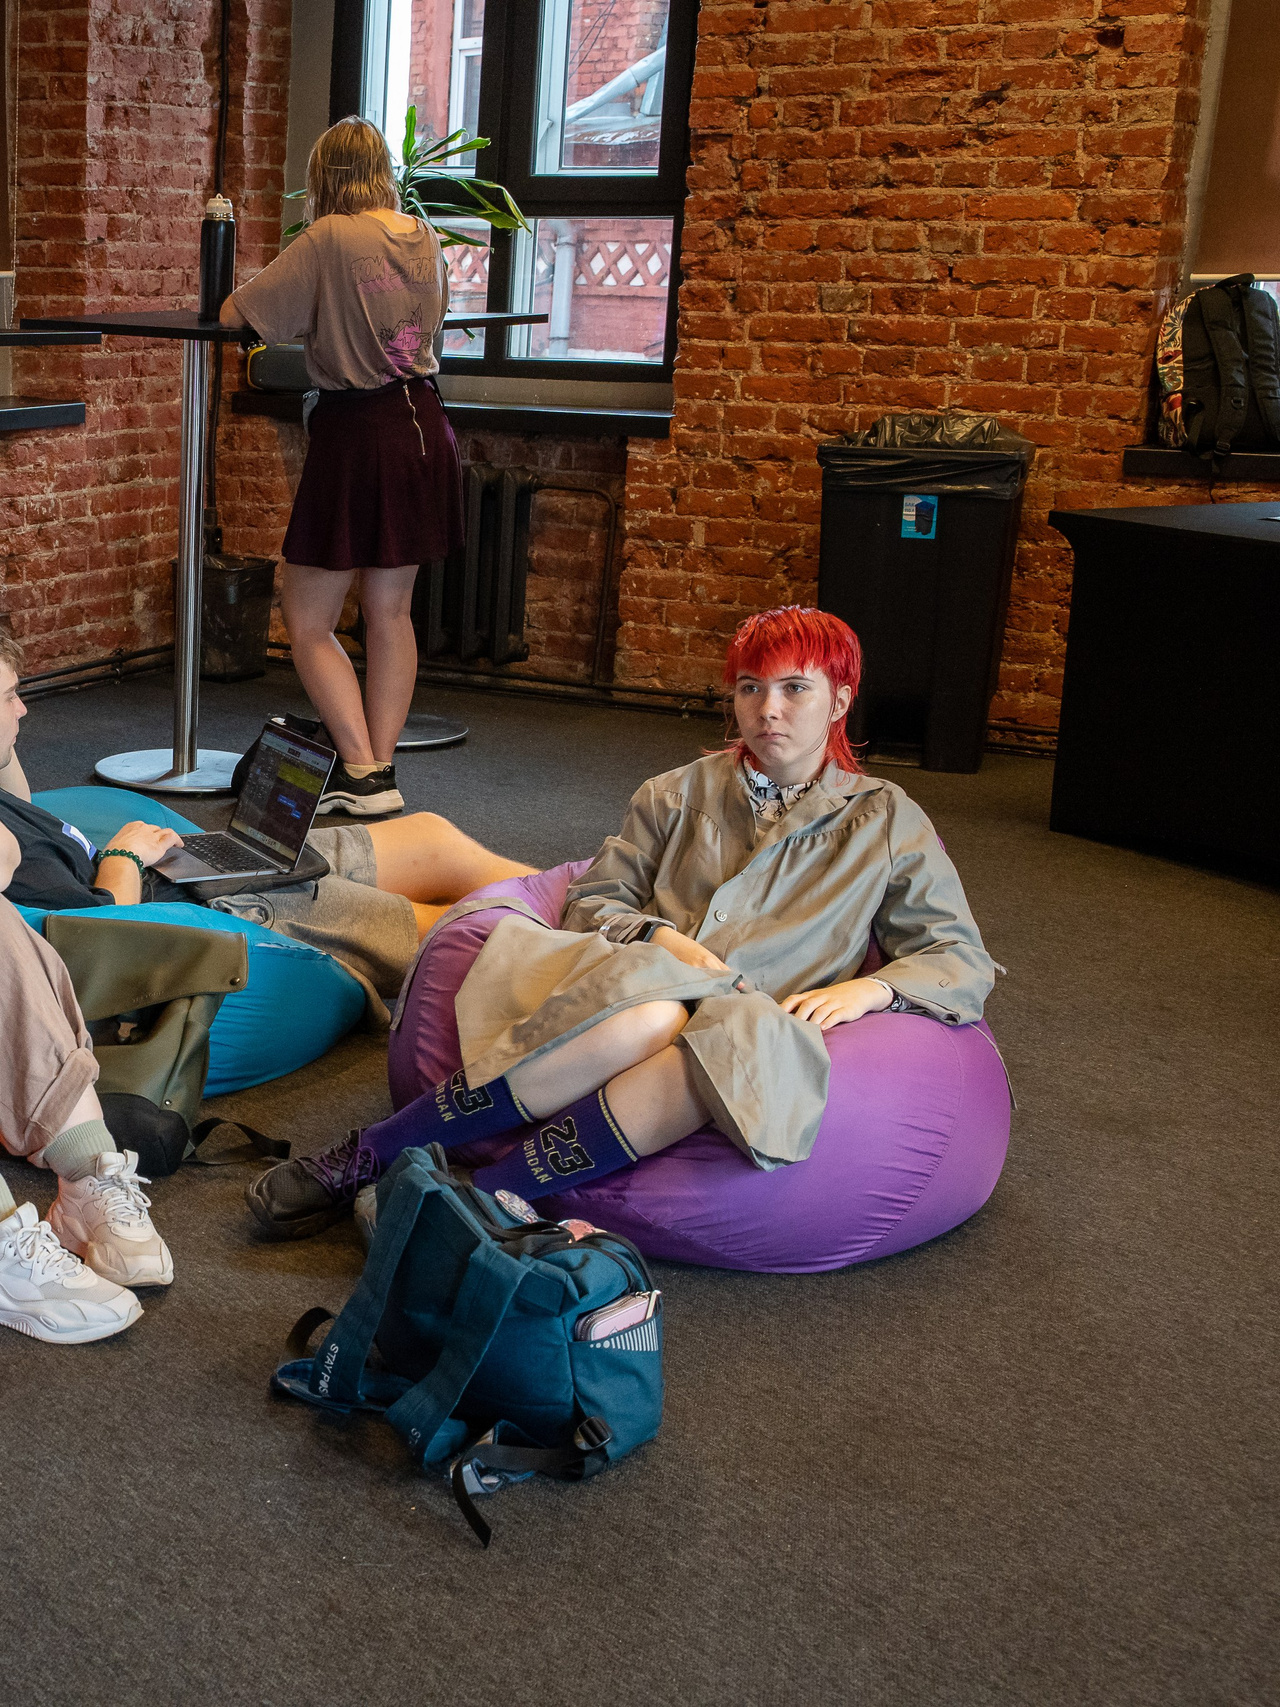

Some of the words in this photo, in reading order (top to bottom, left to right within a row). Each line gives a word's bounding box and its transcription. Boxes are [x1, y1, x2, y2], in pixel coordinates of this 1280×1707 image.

[523, 1138, 553, 1184] JORDAN
[540, 1116, 596, 1176] 23
[324, 1343, 339, 1374] STAY
